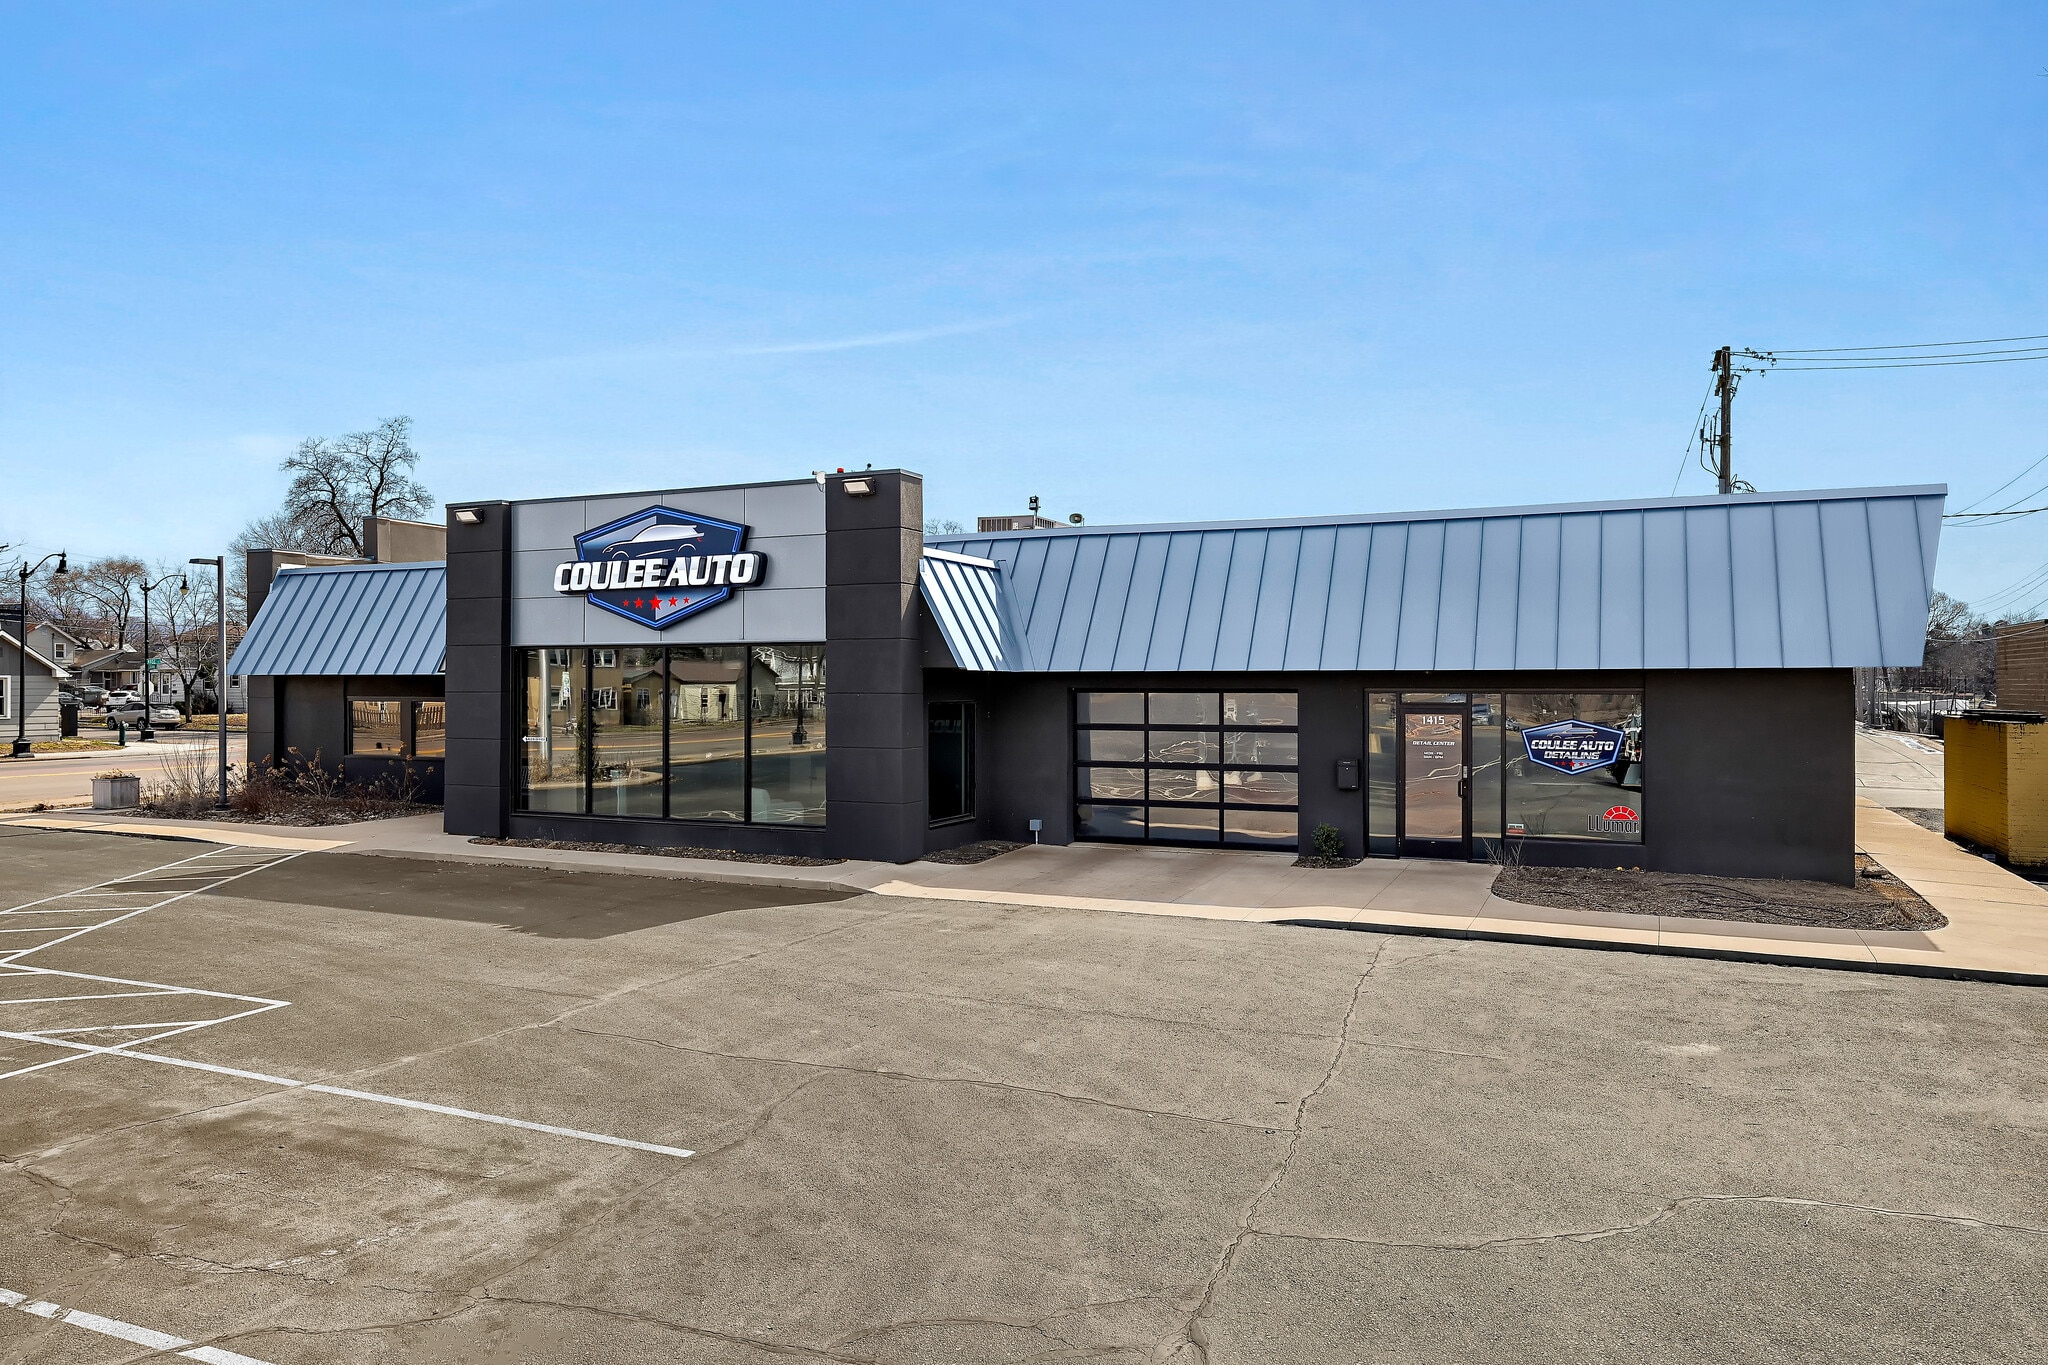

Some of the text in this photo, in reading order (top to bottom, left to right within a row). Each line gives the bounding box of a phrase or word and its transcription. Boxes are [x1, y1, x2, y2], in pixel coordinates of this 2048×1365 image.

[554, 553, 757, 591] COULEE AUTO
[1422, 715, 1445, 725] 1415
[1531, 740, 1615, 751] COULEE AUTO
[1544, 751, 1601, 760] DETAILING
[1587, 814, 1640, 833] LLumar
